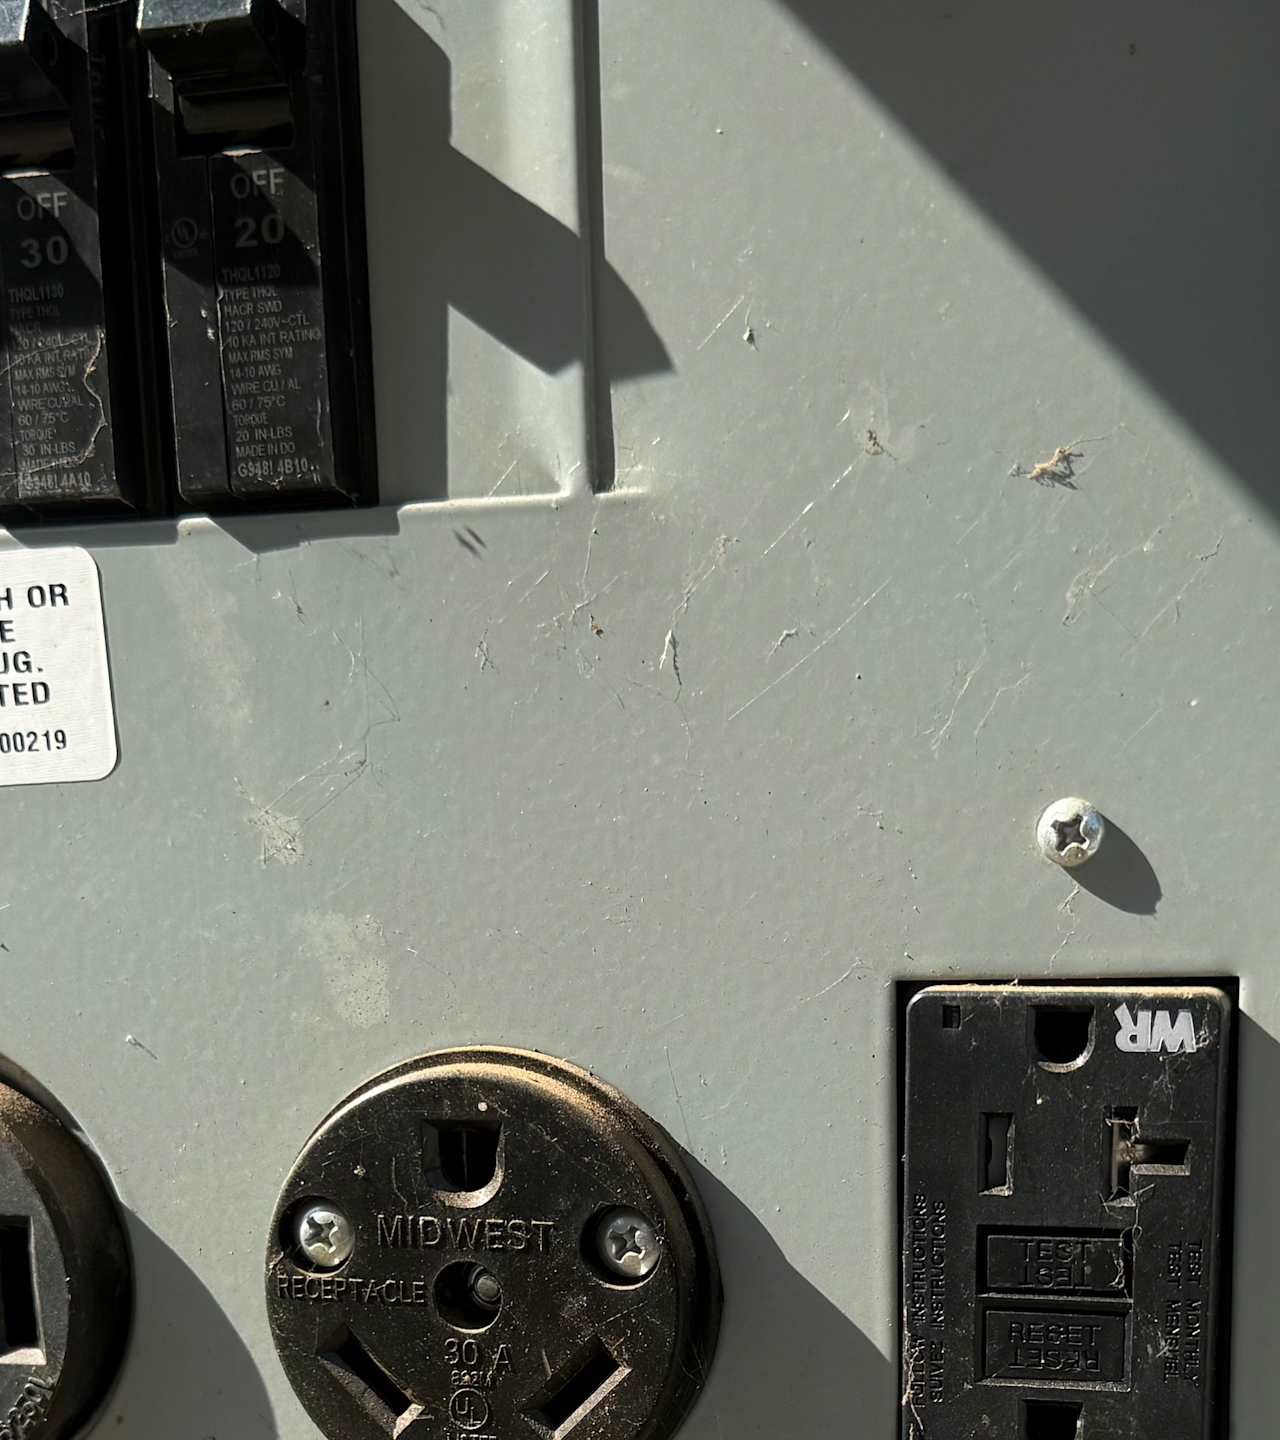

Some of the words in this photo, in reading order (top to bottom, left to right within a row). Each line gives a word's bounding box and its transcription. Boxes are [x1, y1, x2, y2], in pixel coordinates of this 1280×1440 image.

[230, 168, 285, 199] OFF
[17, 192, 68, 221] OFF
[234, 215, 284, 248] 20
[20, 235, 69, 269] 30
[224, 288, 249, 302] TYPE
[224, 303, 253, 318] HACR
[257, 301, 282, 313] SWD
[260, 332, 276, 345] INT
[280, 328, 321, 343] RATING
[229, 352, 249, 363] MAX
[250, 349, 271, 361] RMS
[272, 346, 293, 359] SYM
[258, 364, 281, 376] AWG
[232, 383, 259, 395] WIRE
[18, 399, 45, 411] WIRE
[233, 414, 269, 427] TORQUE
[19, 428, 55, 441] TORQUE
[236, 430, 249, 442] 20
[236, 445, 266, 458] MADE
[268, 443, 278, 456] IN
[26, 582, 69, 608] OR
[1115, 1003, 1197, 1053] WR
[377, 1214, 556, 1251] MIDWEST
[912, 1193, 927, 1322] INSTRUCTIONS
[1019, 1240, 1091, 1264] TEST
[1168, 1241, 1182, 1288] TEST
[1187, 1240, 1203, 1288] TEST
[930, 1200, 946, 1330] INSTRUCTIONS
[1019, 1266, 1092, 1289] TEST
[277, 1275, 425, 1303] RECEPTACLE
[1009, 1322, 1102, 1346] RESET
[1184, 1298, 1201, 1387] MONTHLY
[443, 1338, 478, 1366] 30
[493, 1344, 512, 1373] A
[1008, 1347, 1100, 1372] RESET
